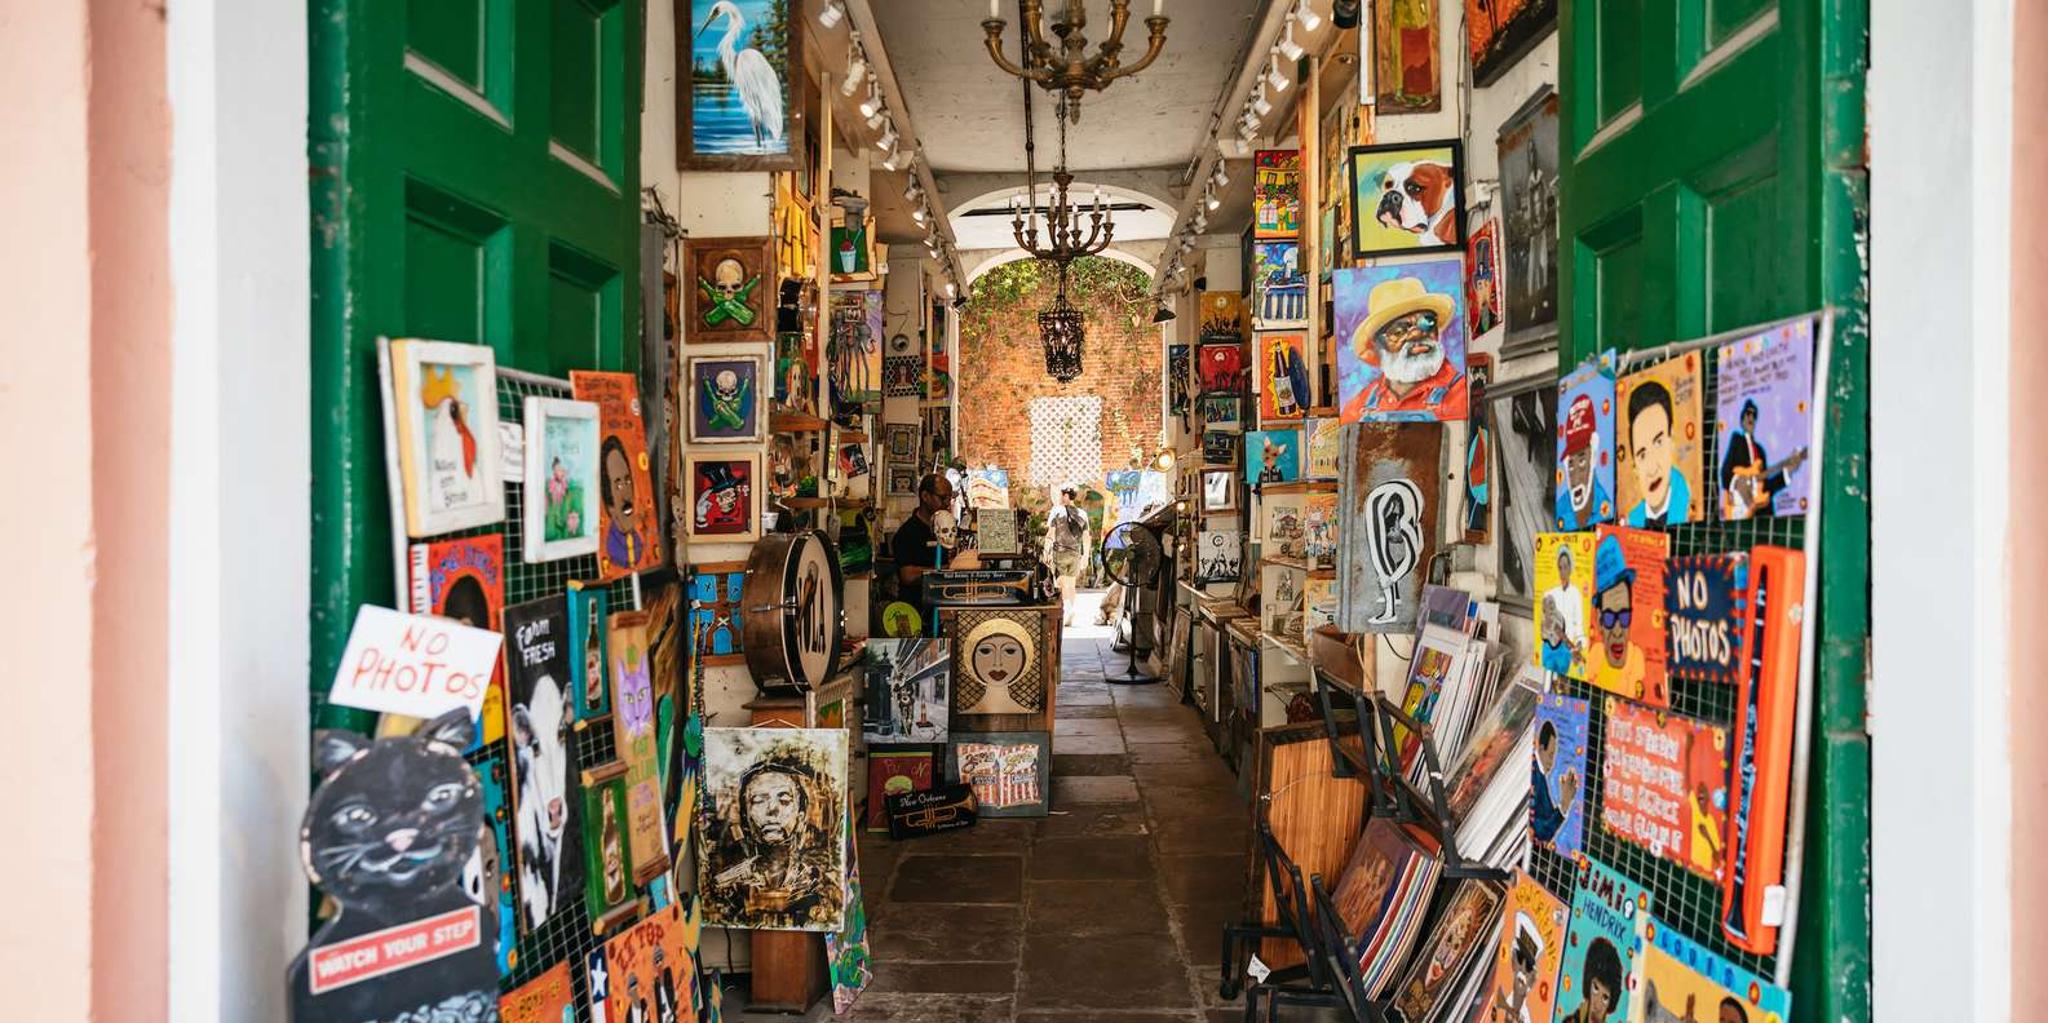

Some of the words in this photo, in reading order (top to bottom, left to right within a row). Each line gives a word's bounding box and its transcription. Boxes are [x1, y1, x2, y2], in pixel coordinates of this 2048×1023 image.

[1677, 570, 1708, 610] NO
[401, 625, 449, 655] NO
[523, 640, 555, 667] FRESH
[1670, 613, 1731, 667] PHOTOS
[352, 648, 486, 700] PHOTOS
[635, 922, 664, 947] TOP
[1583, 896, 1627, 944] HENDRIX
[317, 945, 378, 979] WATCH
[384, 932, 430, 960] YOUR
[433, 919, 474, 946] STEP
